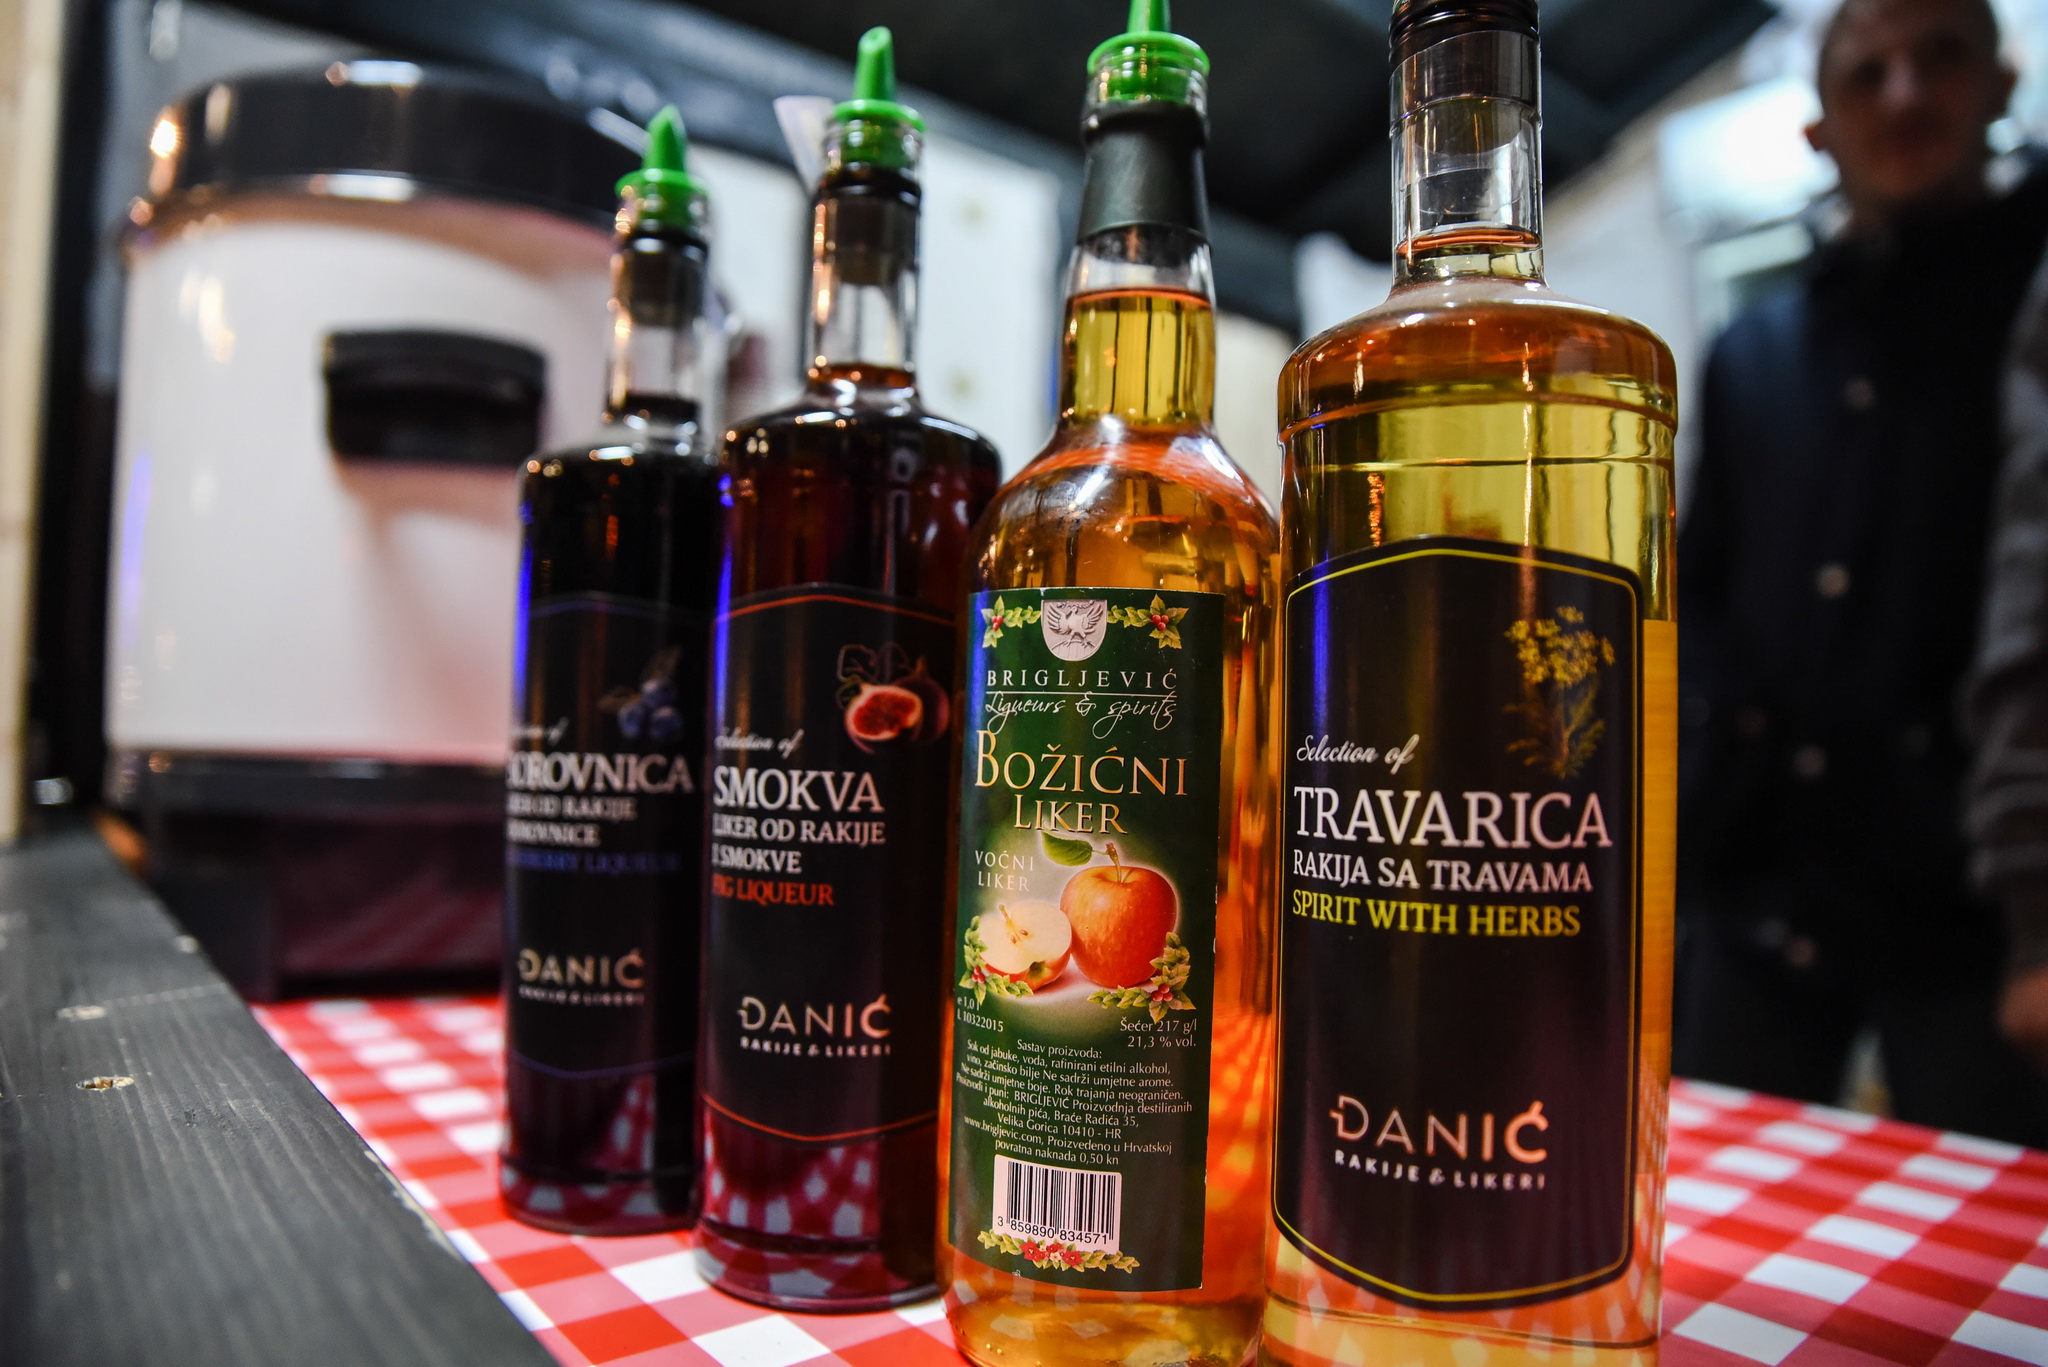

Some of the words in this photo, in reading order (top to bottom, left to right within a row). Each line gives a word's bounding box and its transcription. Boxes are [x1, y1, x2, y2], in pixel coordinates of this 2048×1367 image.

[986, 669, 1177, 689] BRIGLJEVIĆ
[985, 690, 1066, 735] Liqueurs
[1075, 691, 1096, 717] &
[1092, 690, 1177, 739] spirits
[777, 728, 805, 759] of
[1296, 734, 1379, 764] Selection
[1384, 734, 1420, 775] of
[507, 752, 694, 793] OROVNICA
[975, 730, 1187, 796] BOŽIĆNI
[713, 765, 885, 812] SMOKVA
[1014, 794, 1128, 834] LIKER
[1294, 786, 1613, 849] TRAVARICA
[760, 818, 795, 842] OD
[800, 819, 886, 848] RAKIJE
[719, 845, 803, 874] SMOKVE
[975, 848, 1034, 871] VOĆNI
[1293, 849, 1371, 888] RAKIJA
[1377, 857, 1421, 889] SA
[1426, 860, 1594, 893] TRAVAMA
[736, 877, 834, 906] LIQUEUR
[977, 871, 1030, 892] LIKER
[1293, 889, 1361, 926] SPIRIT
[1365, 899, 1459, 936] WITH
[1468, 904, 1582, 937] HERBS
[963, 1010, 1004, 1033] 10322015
[1120, 1016, 1153, 1032] Šećer
[1156, 1020, 1179, 1032] 217
[1182, 1018, 1197, 1035] g/l
[1017, 1038, 1046, 1054] Sastav
[1048, 1045, 1103, 1059] proizvoda:
[1127, 1035, 1155, 1049] 21,3
[1159, 1036, 1172, 1047] %
[1175, 1034, 1197, 1047] vol.
[980, 1044, 990, 1055] od
[991, 1046, 1020, 1064] jabuke,
[1022, 1055, 1048, 1068] voda,
[1051, 1058, 1097, 1071] rafinirani
[1099, 1061, 1126, 1073] etilni
[1129, 1062, 1171, 1075] alkohol,
[970, 1068, 990, 1081] sadrži
[992, 1075, 1026, 1090] umjetne
[1027, 1080, 1051, 1095] boje.
[1054, 1084, 1073, 1096] Rok
[1076, 1087, 1115, 1102] trajanja
[1118, 1089, 1183, 1103] neograničen.
[984, 1060, 1018, 1075] začinsko
[1020, 1065, 1040, 1080] bilje
[1043, 1070, 1057, 1081] Ne
[1060, 1072, 1090, 1085] sadrži
[1093, 1076, 1136, 1089] umjetne
[1138, 1079, 1174, 1087] arome.
[983, 1096, 1026, 1115] alkoholnih
[1028, 1107, 1051, 1120] pića,
[1085, 1113, 1119, 1126] Radića
[1122, 1116, 1139, 1128] 35,
[989, 1087, 1009, 1099] puni:
[1014, 1090, 1069, 1109] BRIGLJEVIĆ
[1072, 1099, 1134, 1115] Proizvodnja
[1137, 1101, 1193, 1114] destiliranih
[997, 1112, 1024, 1128] Velika
[1026, 1118, 1058, 1134] Gorica
[1062, 1125, 1095, 1138] 10410
[1105, 1128, 1122, 1139] HR
[995, 1140, 1033, 1156] povratna
[1035, 1147, 1077, 1162] naknada
[1080, 1152, 1103, 1165] 0,50
[1106, 1154, 1119, 1165] kn
[1047, 1135, 1111, 1152] Proizvedeno
[1124, 1142, 1172, 1155] Hrvatskoj
[1334, 1149, 1420, 1183] RAKIJE
[1429, 1167, 1445, 1187] &
[1453, 1171, 1546, 1191] LIKERI
[997, 1216, 1004, 1227] 3
[1010, 1219, 1055, 1239] 859890
[1059, 1229, 1108, 1245] 834571
